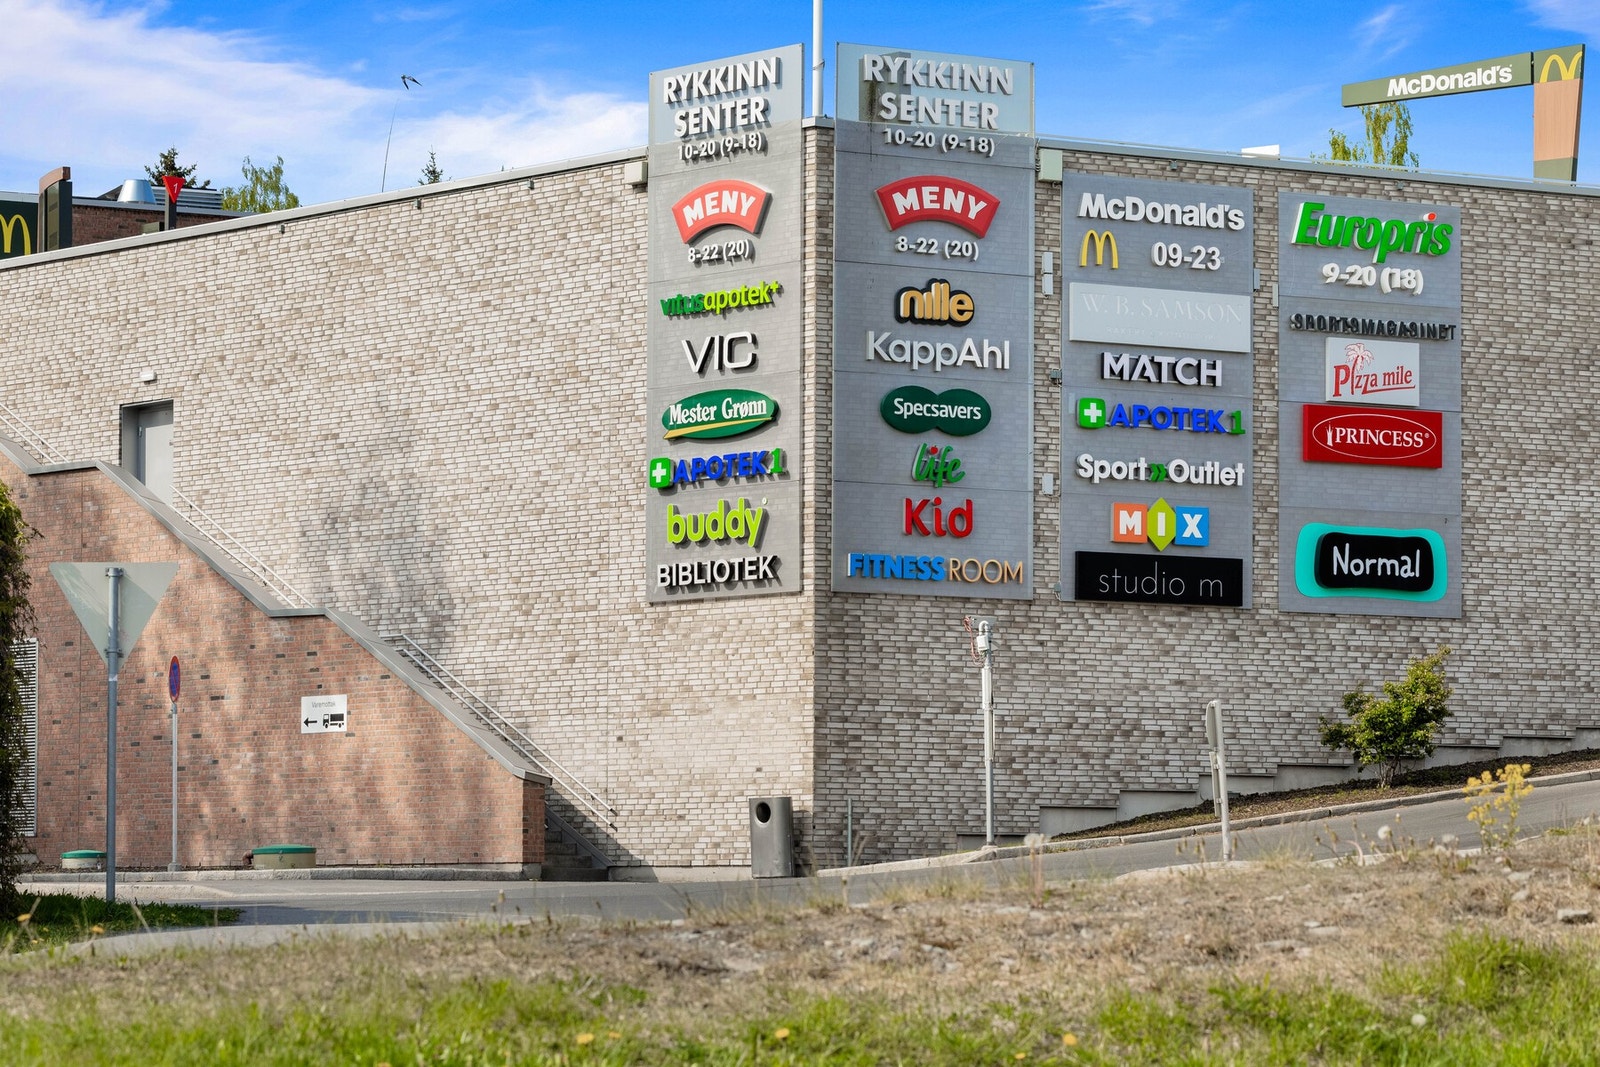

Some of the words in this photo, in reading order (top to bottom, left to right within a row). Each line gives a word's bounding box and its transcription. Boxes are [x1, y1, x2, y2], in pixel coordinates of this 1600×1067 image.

[663, 57, 779, 104] RYKKINN
[863, 54, 1014, 95] RYKKINN
[1387, 65, 1511, 97] McDonald's
[674, 96, 767, 138] SENTER
[878, 92, 999, 130] SENTER
[678, 140, 717, 161] 10-20
[720, 131, 763, 157] (9-18)
[884, 127, 936, 149] 10-20
[941, 132, 995, 157] (9-18)
[682, 190, 757, 228] MENY
[892, 186, 988, 220] MENY
[1077, 192, 1246, 231] McDonald's
[895, 236, 939, 255] 8-22
[944, 239, 979, 262] (20)
[1291, 202, 1454, 264] Europris
[688, 244, 719, 263] 8-22
[722, 239, 750, 261] (20)
[1151, 241, 1222, 271] 09-23
[1321, 262, 1377, 286] 9-20
[1380, 266, 1424, 296] (18)
[900, 282, 975, 322] nille
[1141, 299, 1242, 322] SAMSON
[1289, 313, 1457, 341] SPORTSMAGASINET
[681, 331, 757, 373] VIC
[866, 330, 1010, 372] KappAhl
[1101, 352, 1223, 387] MATCH
[1333, 355, 1378, 397] Pizza
[1382, 365, 1413, 387] mile
[669, 402, 718, 426] Mester
[721, 398, 767, 419] Grønn
[894, 397, 982, 420] Specsavers
[912, 443, 966, 488] life
[667, 497, 763, 547] buddy
[903, 497, 974, 538] Kid
[1119, 510, 1203, 538] MIX
[657, 555, 775, 588] BIBLIOTEK
[848, 553, 945, 581] FITNESS
[949, 558, 1023, 585] ROOM
[1331, 542, 1421, 578] Normal
[1099, 561, 1186, 596] studio
[1199, 578, 1223, 597] m
